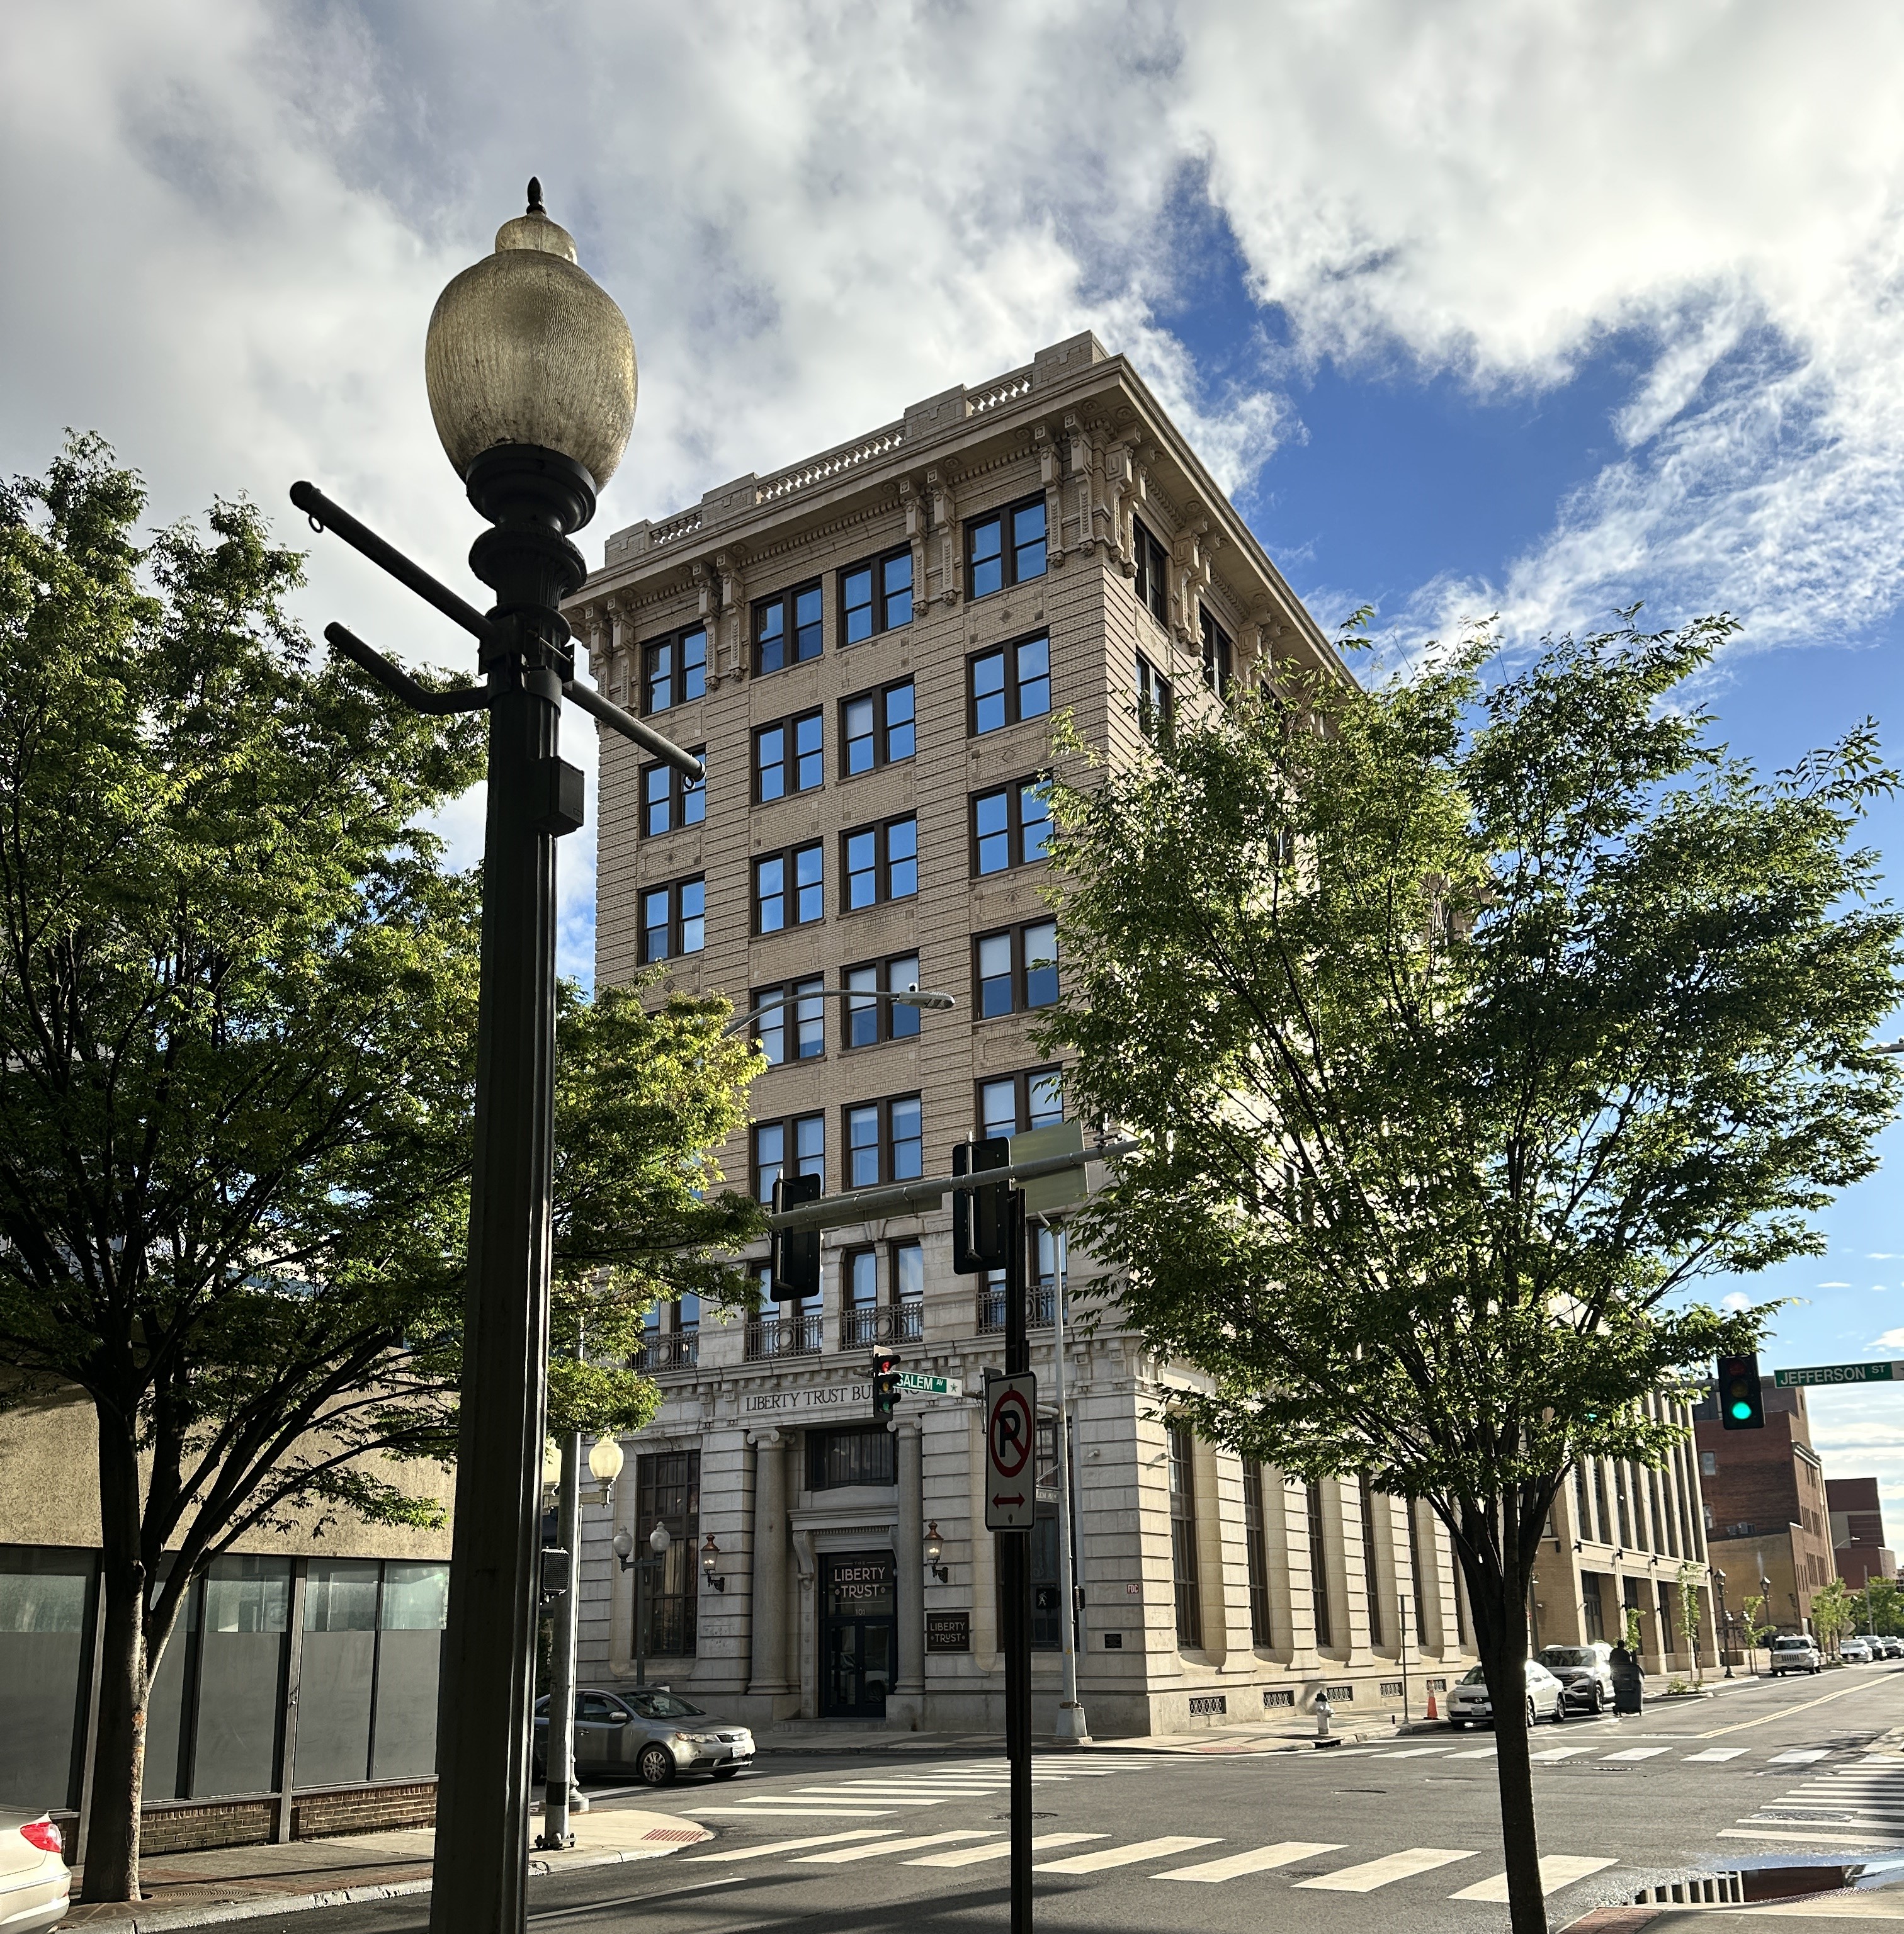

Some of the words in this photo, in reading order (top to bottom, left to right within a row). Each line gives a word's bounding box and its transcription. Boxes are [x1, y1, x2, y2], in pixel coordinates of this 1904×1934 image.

[897, 1373, 933, 1390] SALEM
[1781, 1366, 1866, 1386] JEFFERSON
[1871, 1365, 1885, 1374] ST
[746, 1392, 800, 1411] LIBERTY
[803, 1388, 847, 1405] TRUST
[834, 1567, 885, 1581] LIBERTY
[841, 1584, 880, 1598] TRUST
[930, 1622, 965, 1631] LIBERTY
[935, 1633, 961, 1643] TRUST
